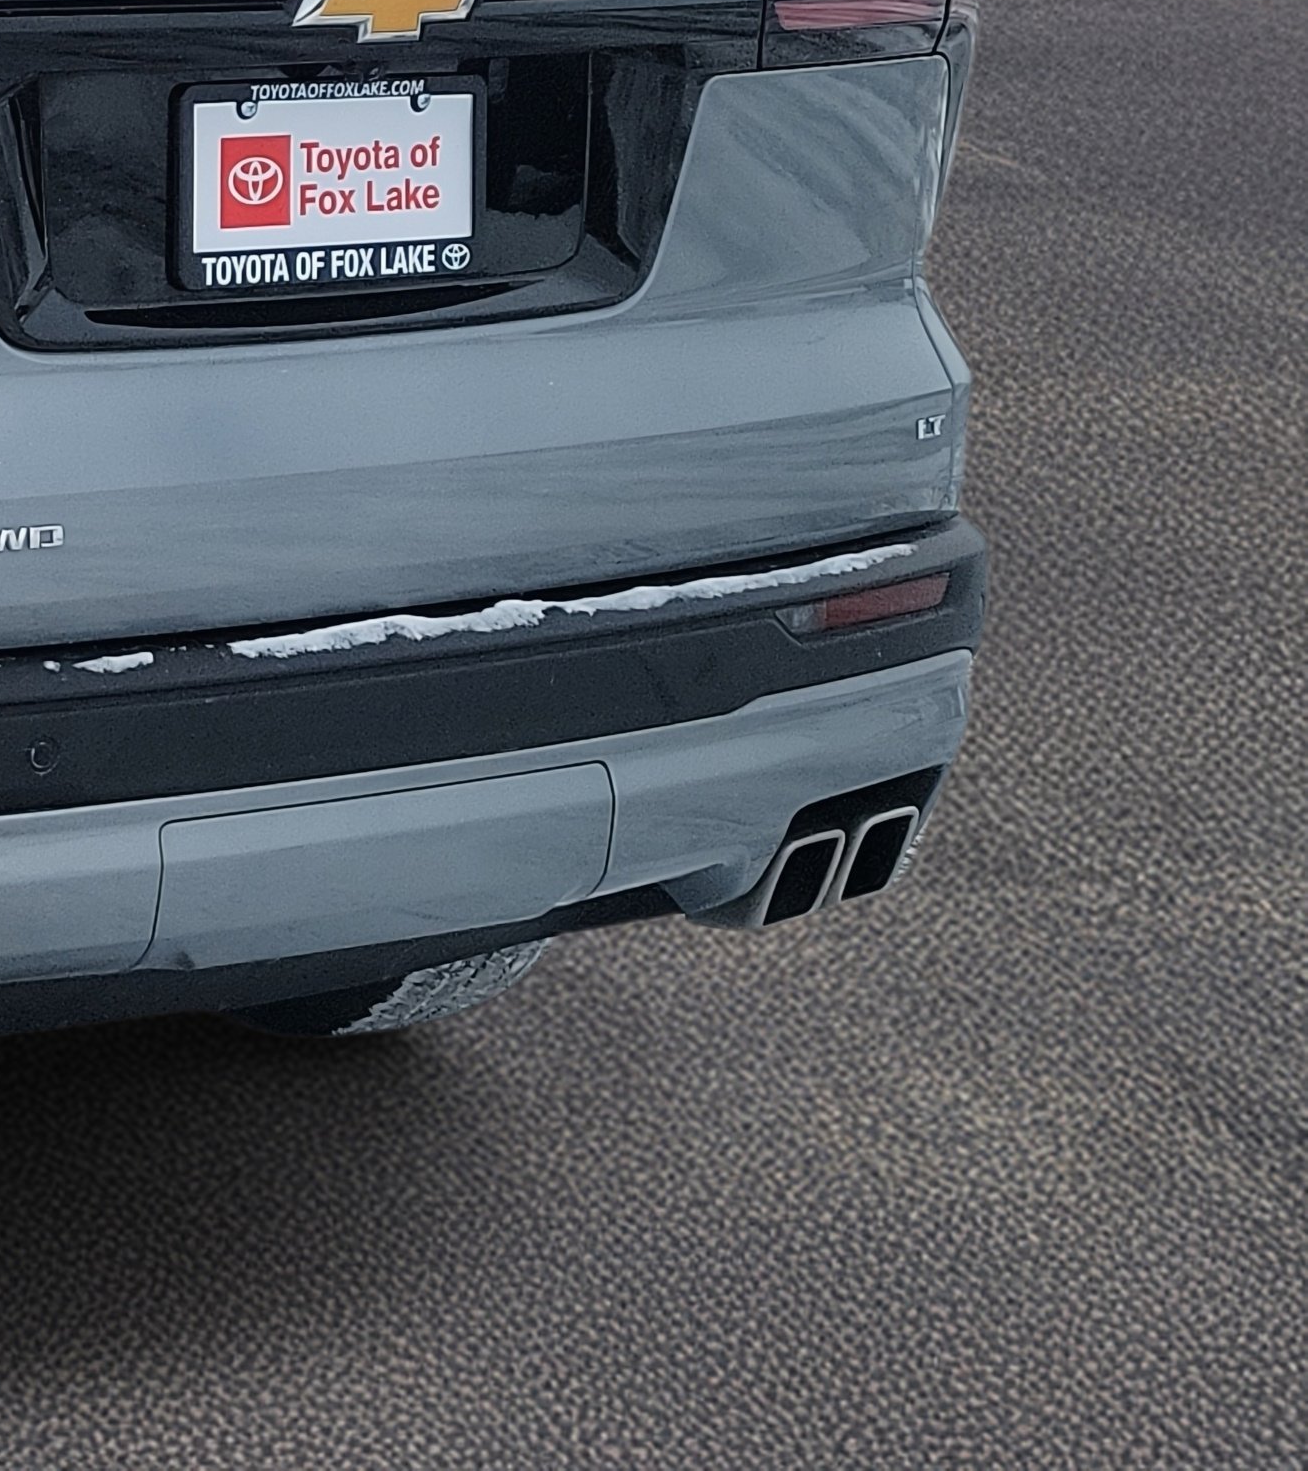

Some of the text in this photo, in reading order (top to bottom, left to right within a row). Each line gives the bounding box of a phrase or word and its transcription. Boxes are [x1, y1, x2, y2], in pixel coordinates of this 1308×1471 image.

[250, 79, 425, 101] TOYOTAOFFOXLAKE.COM
[299, 135, 441, 181] Toyota of
[299, 178, 441, 216] Fox Lake
[201, 244, 436, 286] TOYOTA OF FOX LAKE
[917, 414, 946, 440] LT
